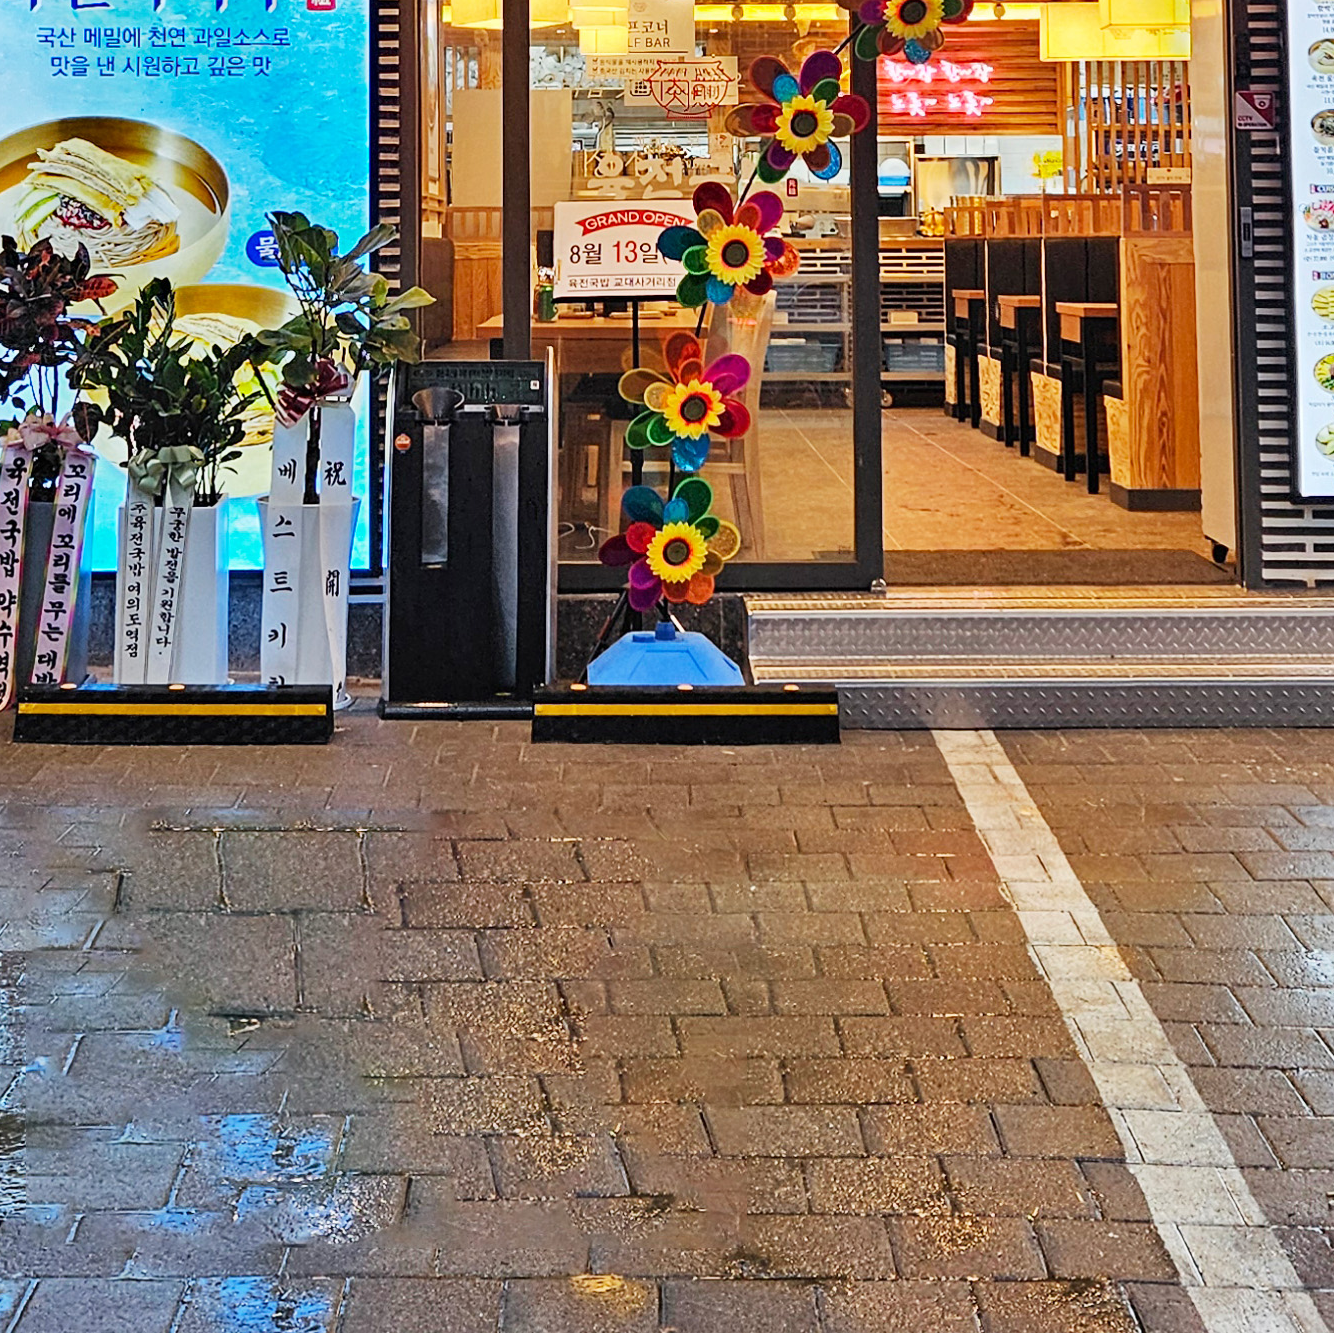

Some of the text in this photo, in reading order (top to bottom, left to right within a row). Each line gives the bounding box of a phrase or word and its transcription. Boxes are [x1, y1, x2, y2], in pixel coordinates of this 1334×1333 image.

[35, 27, 291, 48] 국산 메밀에 천연 과일소스로
[628, 19, 668, 35] 프코너
[645, 37, 670, 48] BAR
[50, 56, 271, 78] 맛을 낸 시원하고 깊은 맛
[585, 211, 686, 230] GRAND OPEN
[569, 243, 602, 265] 8월
[569, 277, 676, 288] 육전국밥 교대사거리점
[57, 462, 88, 524] 꼬리에
[168, 506, 186, 543] 무궁한
[47, 532, 76, 594] 꼬리를
[162, 547, 183, 584] 발전을
[40, 599, 67, 643] 무는
[124, 581, 142, 658] 여의도역점
